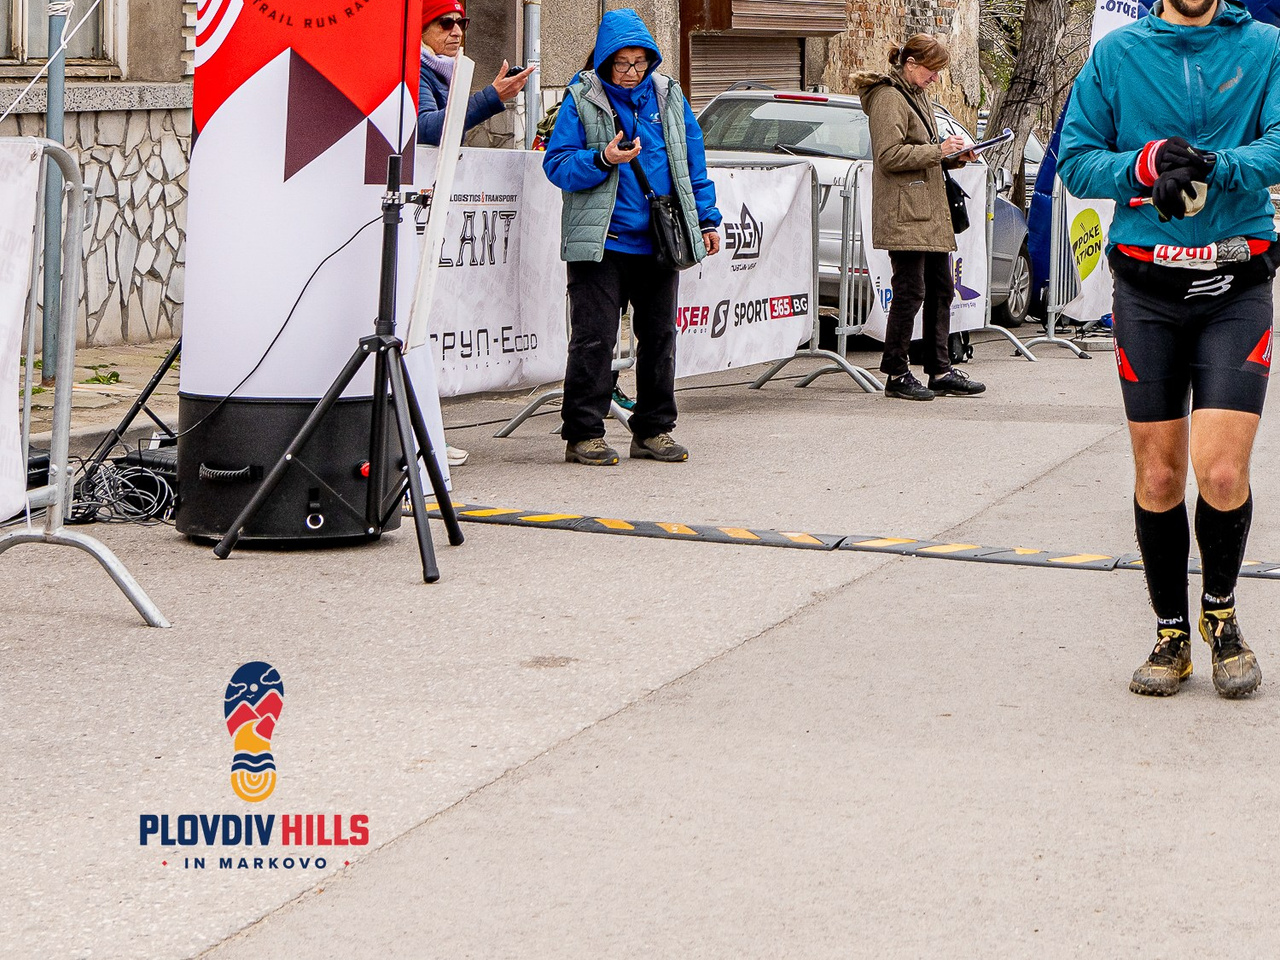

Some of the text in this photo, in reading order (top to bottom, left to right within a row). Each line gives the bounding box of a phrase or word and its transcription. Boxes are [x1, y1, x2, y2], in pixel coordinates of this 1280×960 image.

[304, 14, 337, 28] RUN
[1078, 224, 1100, 249] POKE
[1076, 239, 1102, 266] ATION
[1156, 245, 1213, 262] 4290
